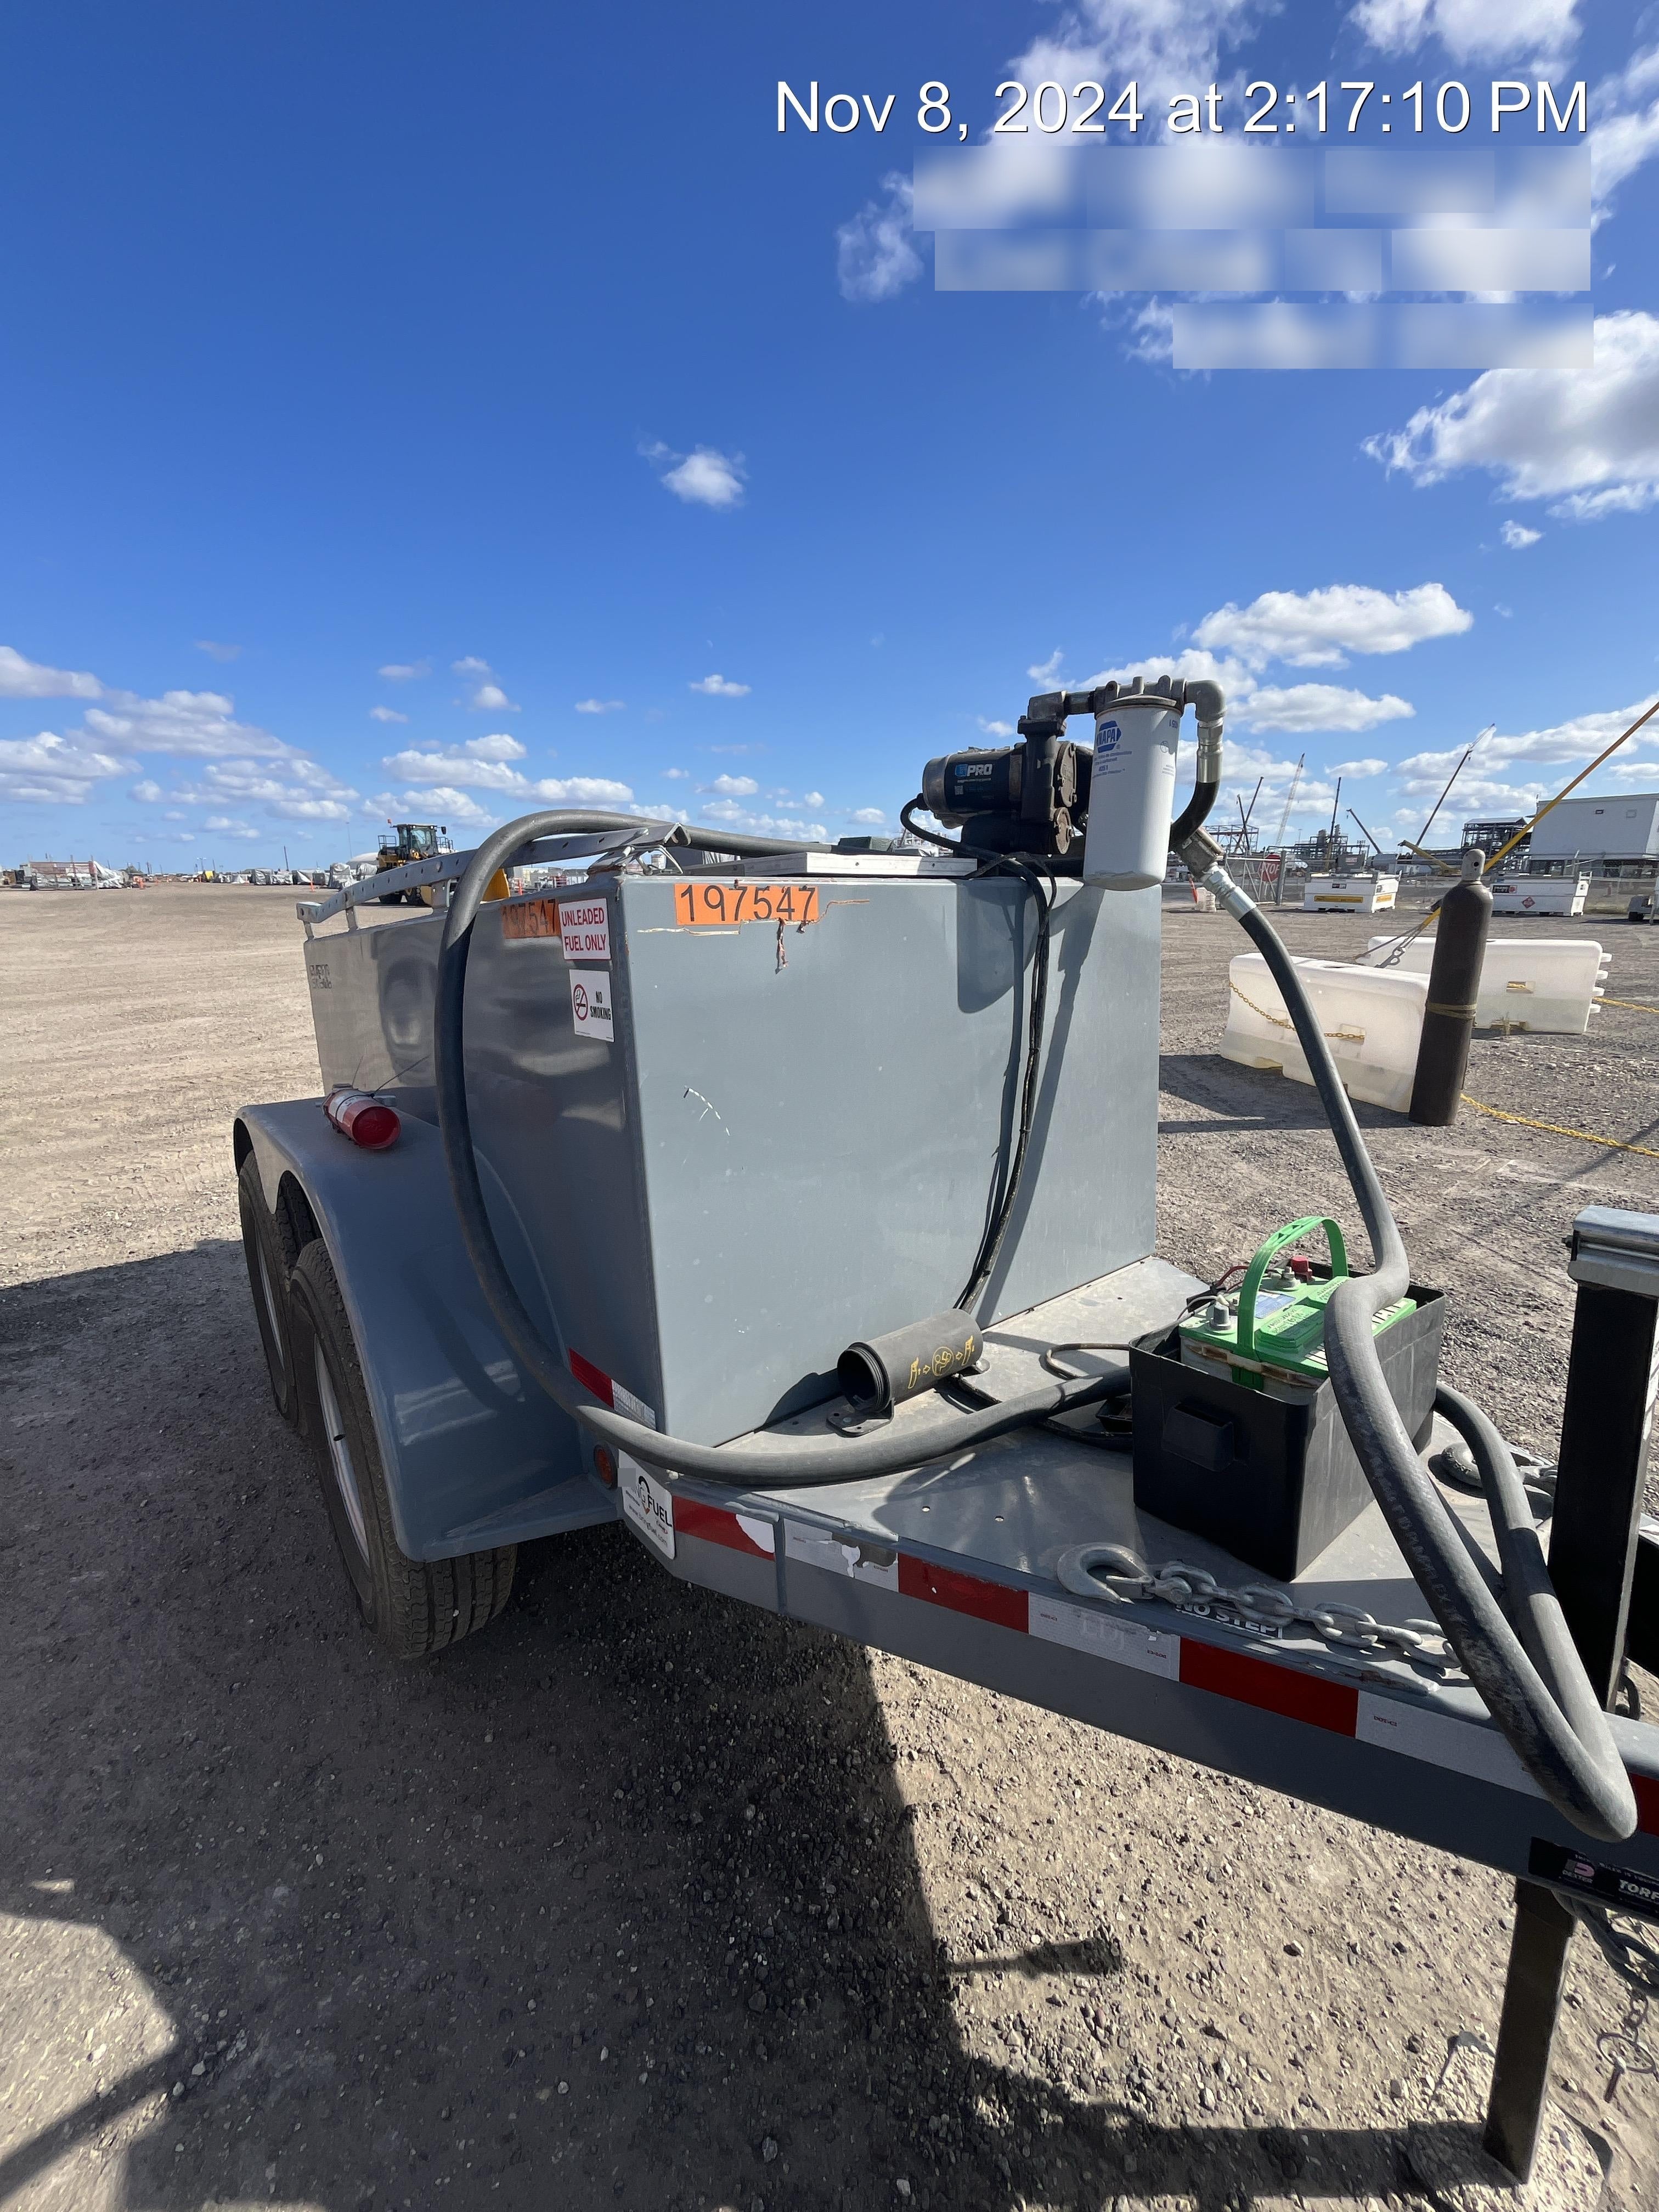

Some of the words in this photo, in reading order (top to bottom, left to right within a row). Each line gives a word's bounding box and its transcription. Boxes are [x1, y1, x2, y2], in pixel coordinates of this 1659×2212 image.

[1097, 728, 1116, 746] NAPA
[680, 884, 816, 923] 197547
[561, 907, 605, 927] UNLEADED
[564, 935, 584, 952] FUEL
[584, 934, 607, 951] ONLY
[595, 991, 603, 1004] NO
[590, 1006, 611, 1020] SMOKING
[647, 1493, 672, 1528] FUEL
